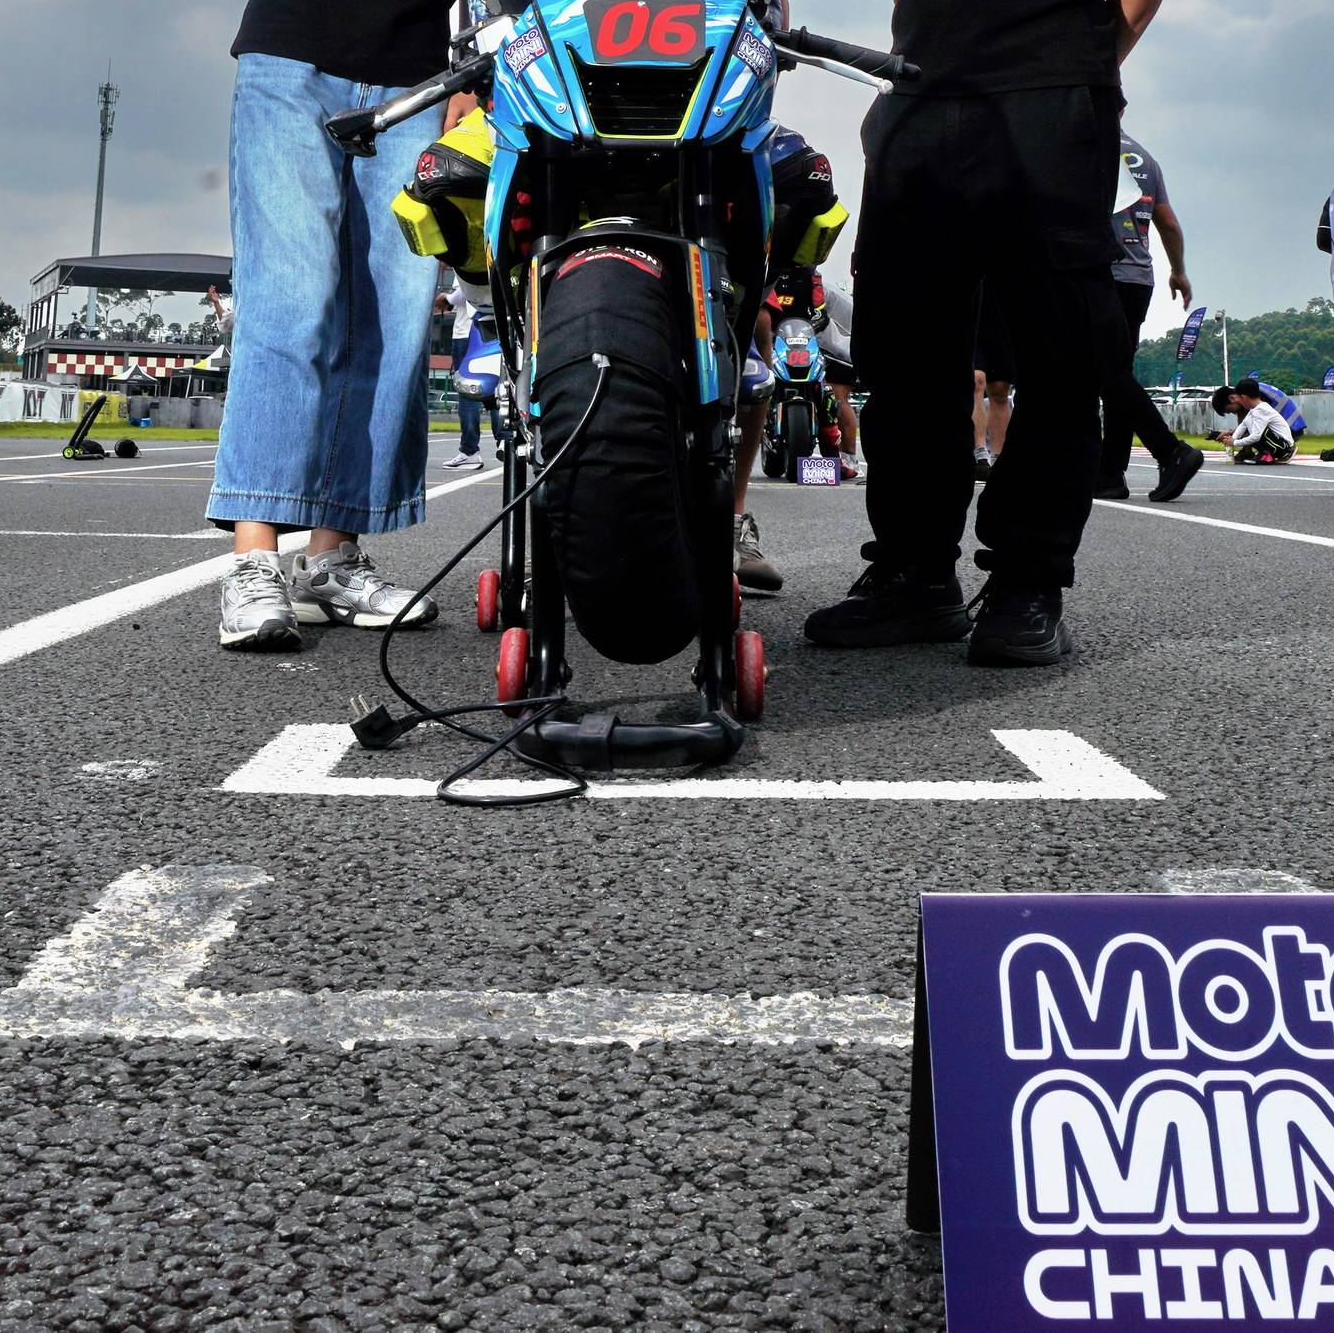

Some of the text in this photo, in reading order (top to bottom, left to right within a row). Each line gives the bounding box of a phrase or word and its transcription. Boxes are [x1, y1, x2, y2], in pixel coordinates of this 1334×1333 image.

[596, 1, 700, 57] 06
[803, 459, 835, 468] Moto
[803, 468, 835, 479] MINI
